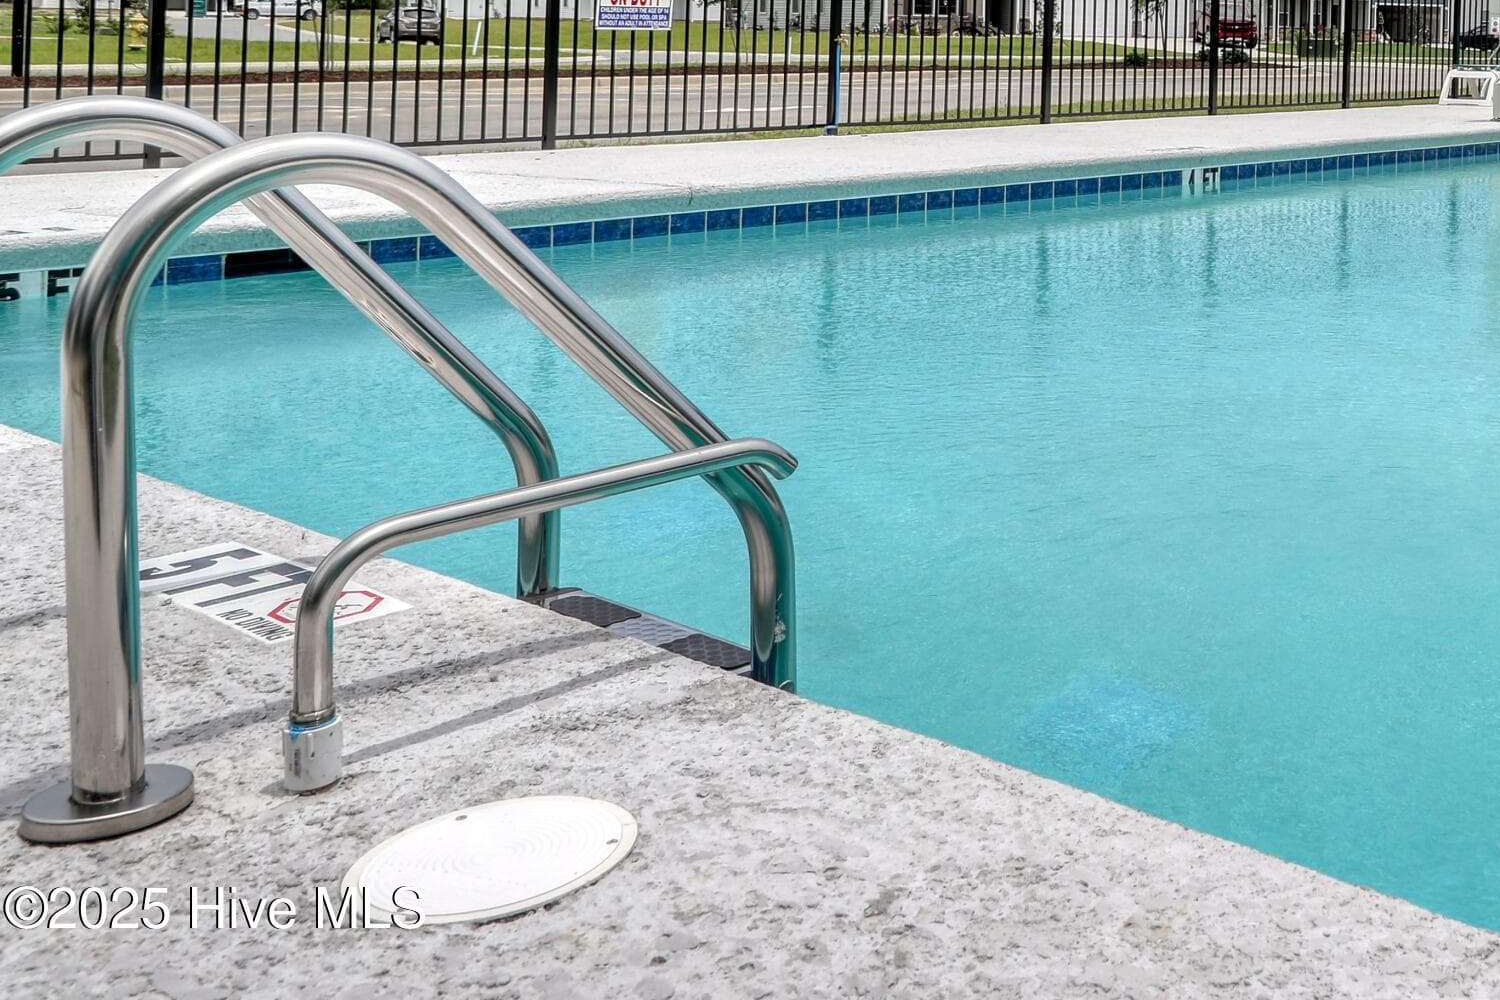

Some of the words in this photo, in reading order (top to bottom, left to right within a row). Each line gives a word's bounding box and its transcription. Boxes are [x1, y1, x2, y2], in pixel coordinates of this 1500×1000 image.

[139, 548, 263, 581] 5
[161, 562, 314, 608] FT
[215, 608, 254, 621] NO
[234, 616, 295, 642] DIVING
